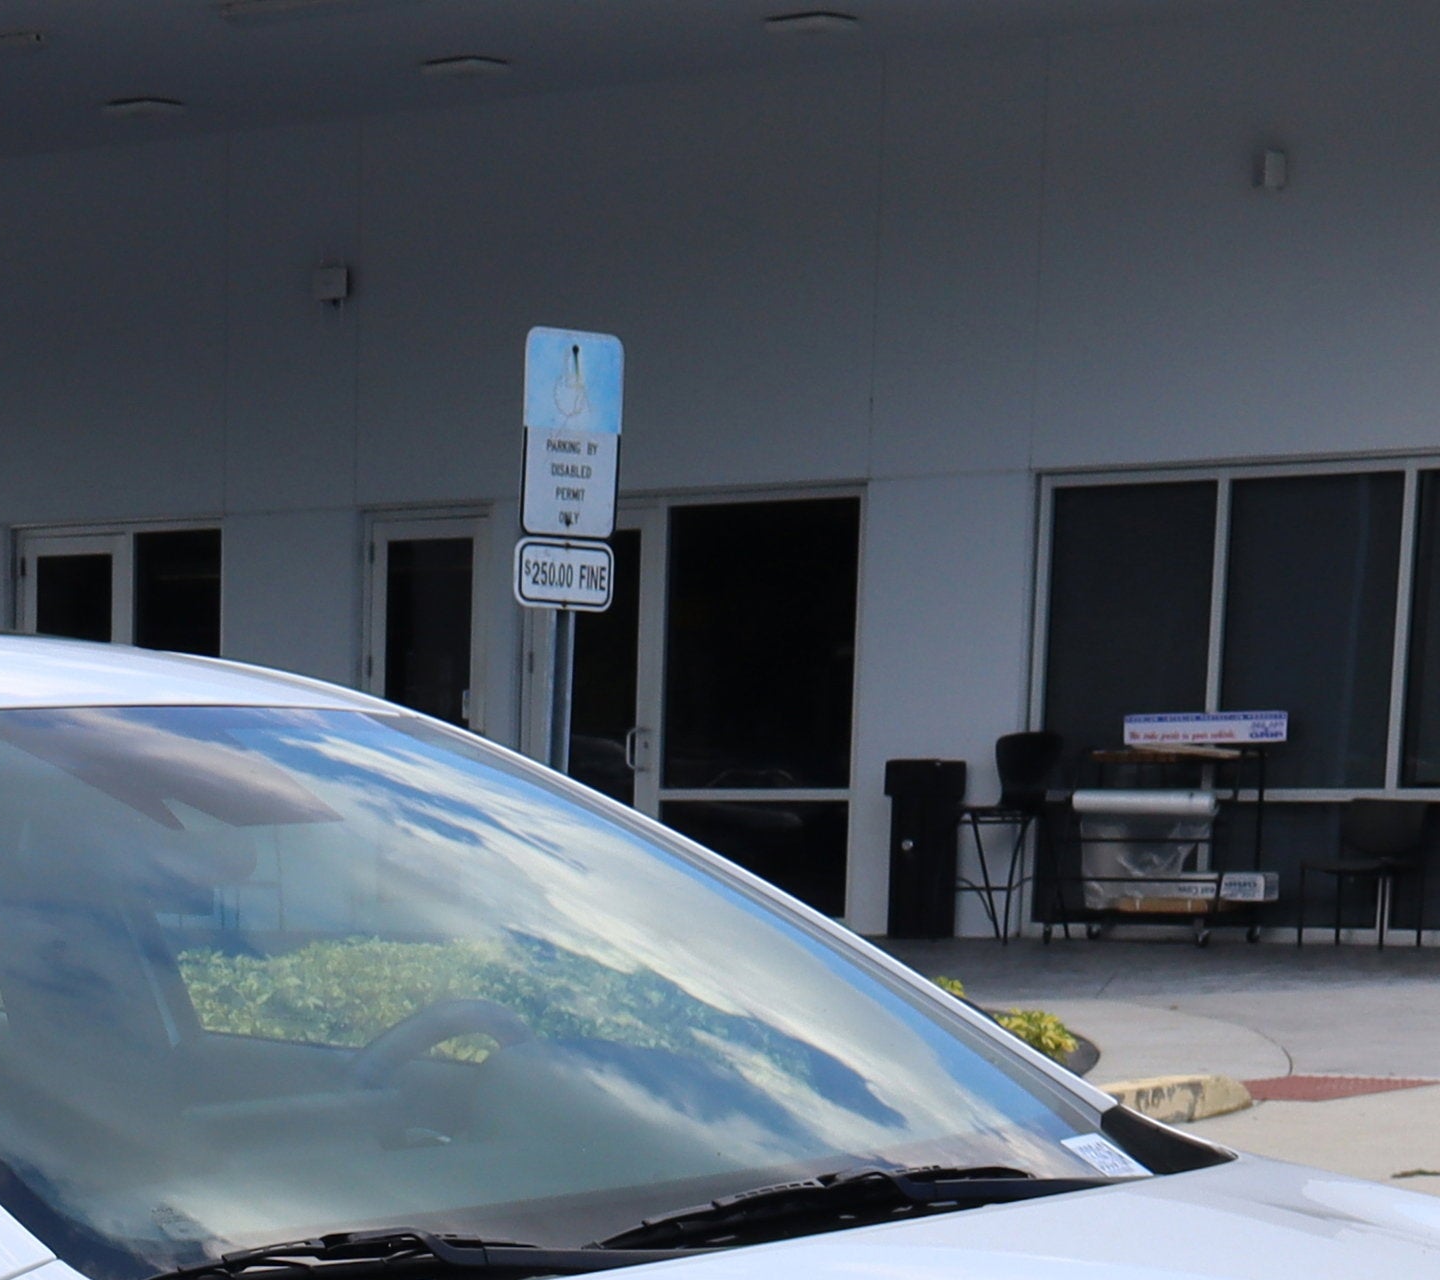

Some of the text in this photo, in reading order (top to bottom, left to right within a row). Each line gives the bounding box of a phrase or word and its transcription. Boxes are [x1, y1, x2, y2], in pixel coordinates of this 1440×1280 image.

[546, 438, 598, 456] PARKING BY
[551, 462, 592, 480] DISABLED
[555, 486, 585, 502] PERMIT
[525, 559, 606, 592] $250.00 FINE
